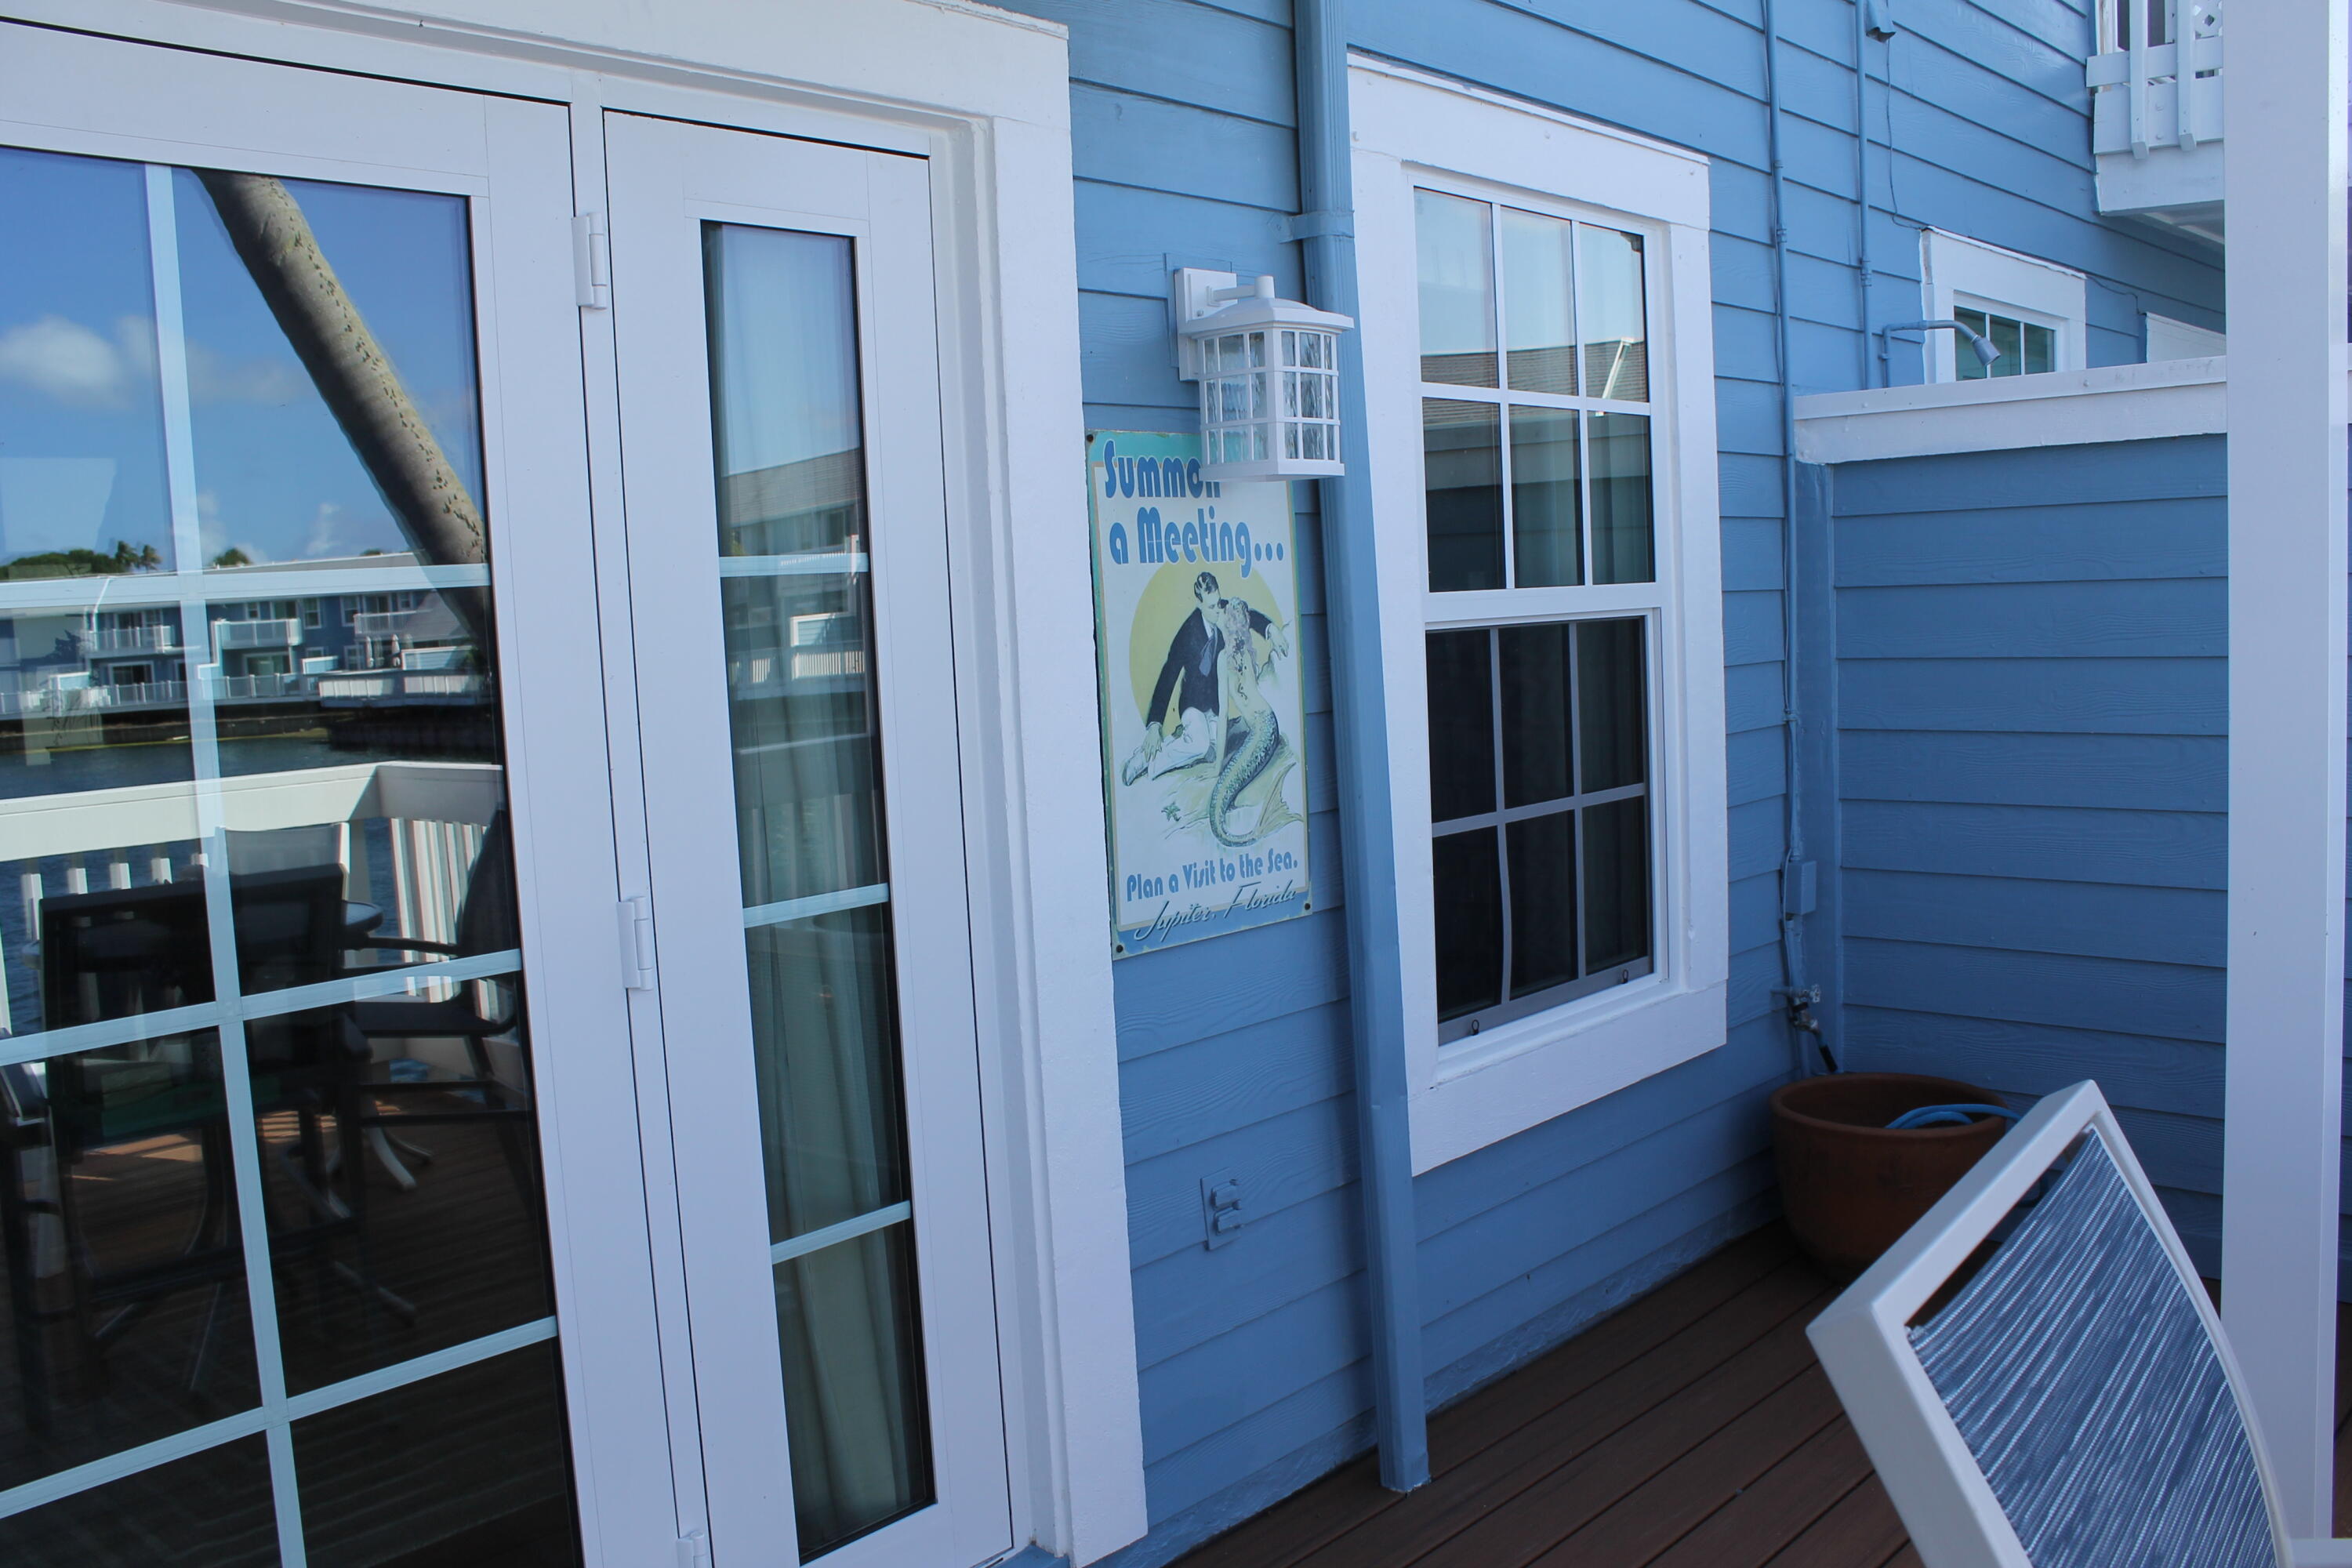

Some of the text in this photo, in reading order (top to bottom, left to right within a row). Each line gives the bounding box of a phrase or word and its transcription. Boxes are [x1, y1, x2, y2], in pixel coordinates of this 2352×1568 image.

[1109, 505, 1283, 578] a Meeting...
[1127, 848, 1298, 902] Plan a Visit to the Sea.
[1224, 879, 1297, 918] Florida
